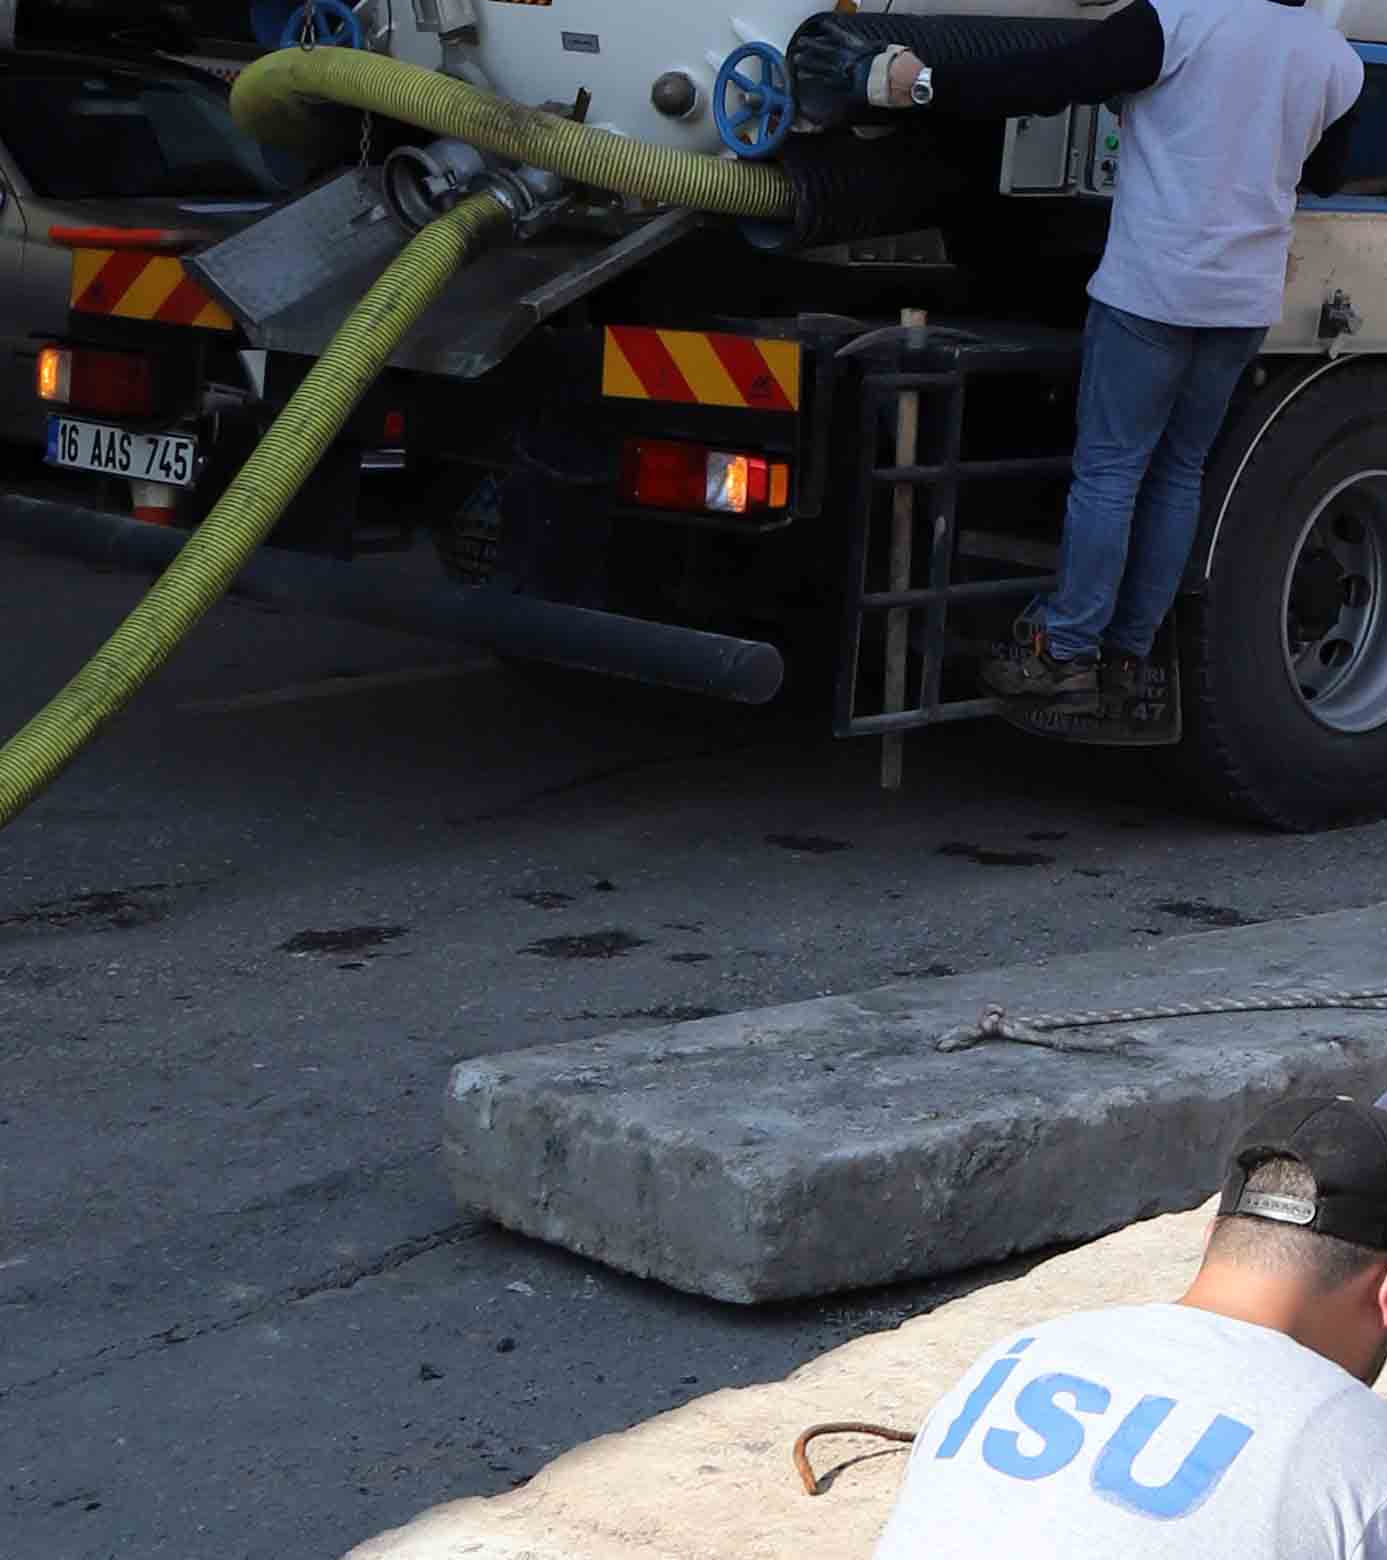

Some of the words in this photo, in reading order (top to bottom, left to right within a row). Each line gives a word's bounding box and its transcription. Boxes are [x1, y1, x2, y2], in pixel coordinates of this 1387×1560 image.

[60, 423, 80, 463] 16
[90, 428, 132, 472] AAS
[145, 437, 189, 481] 745
[934, 1336, 1256, 1521] İSU
